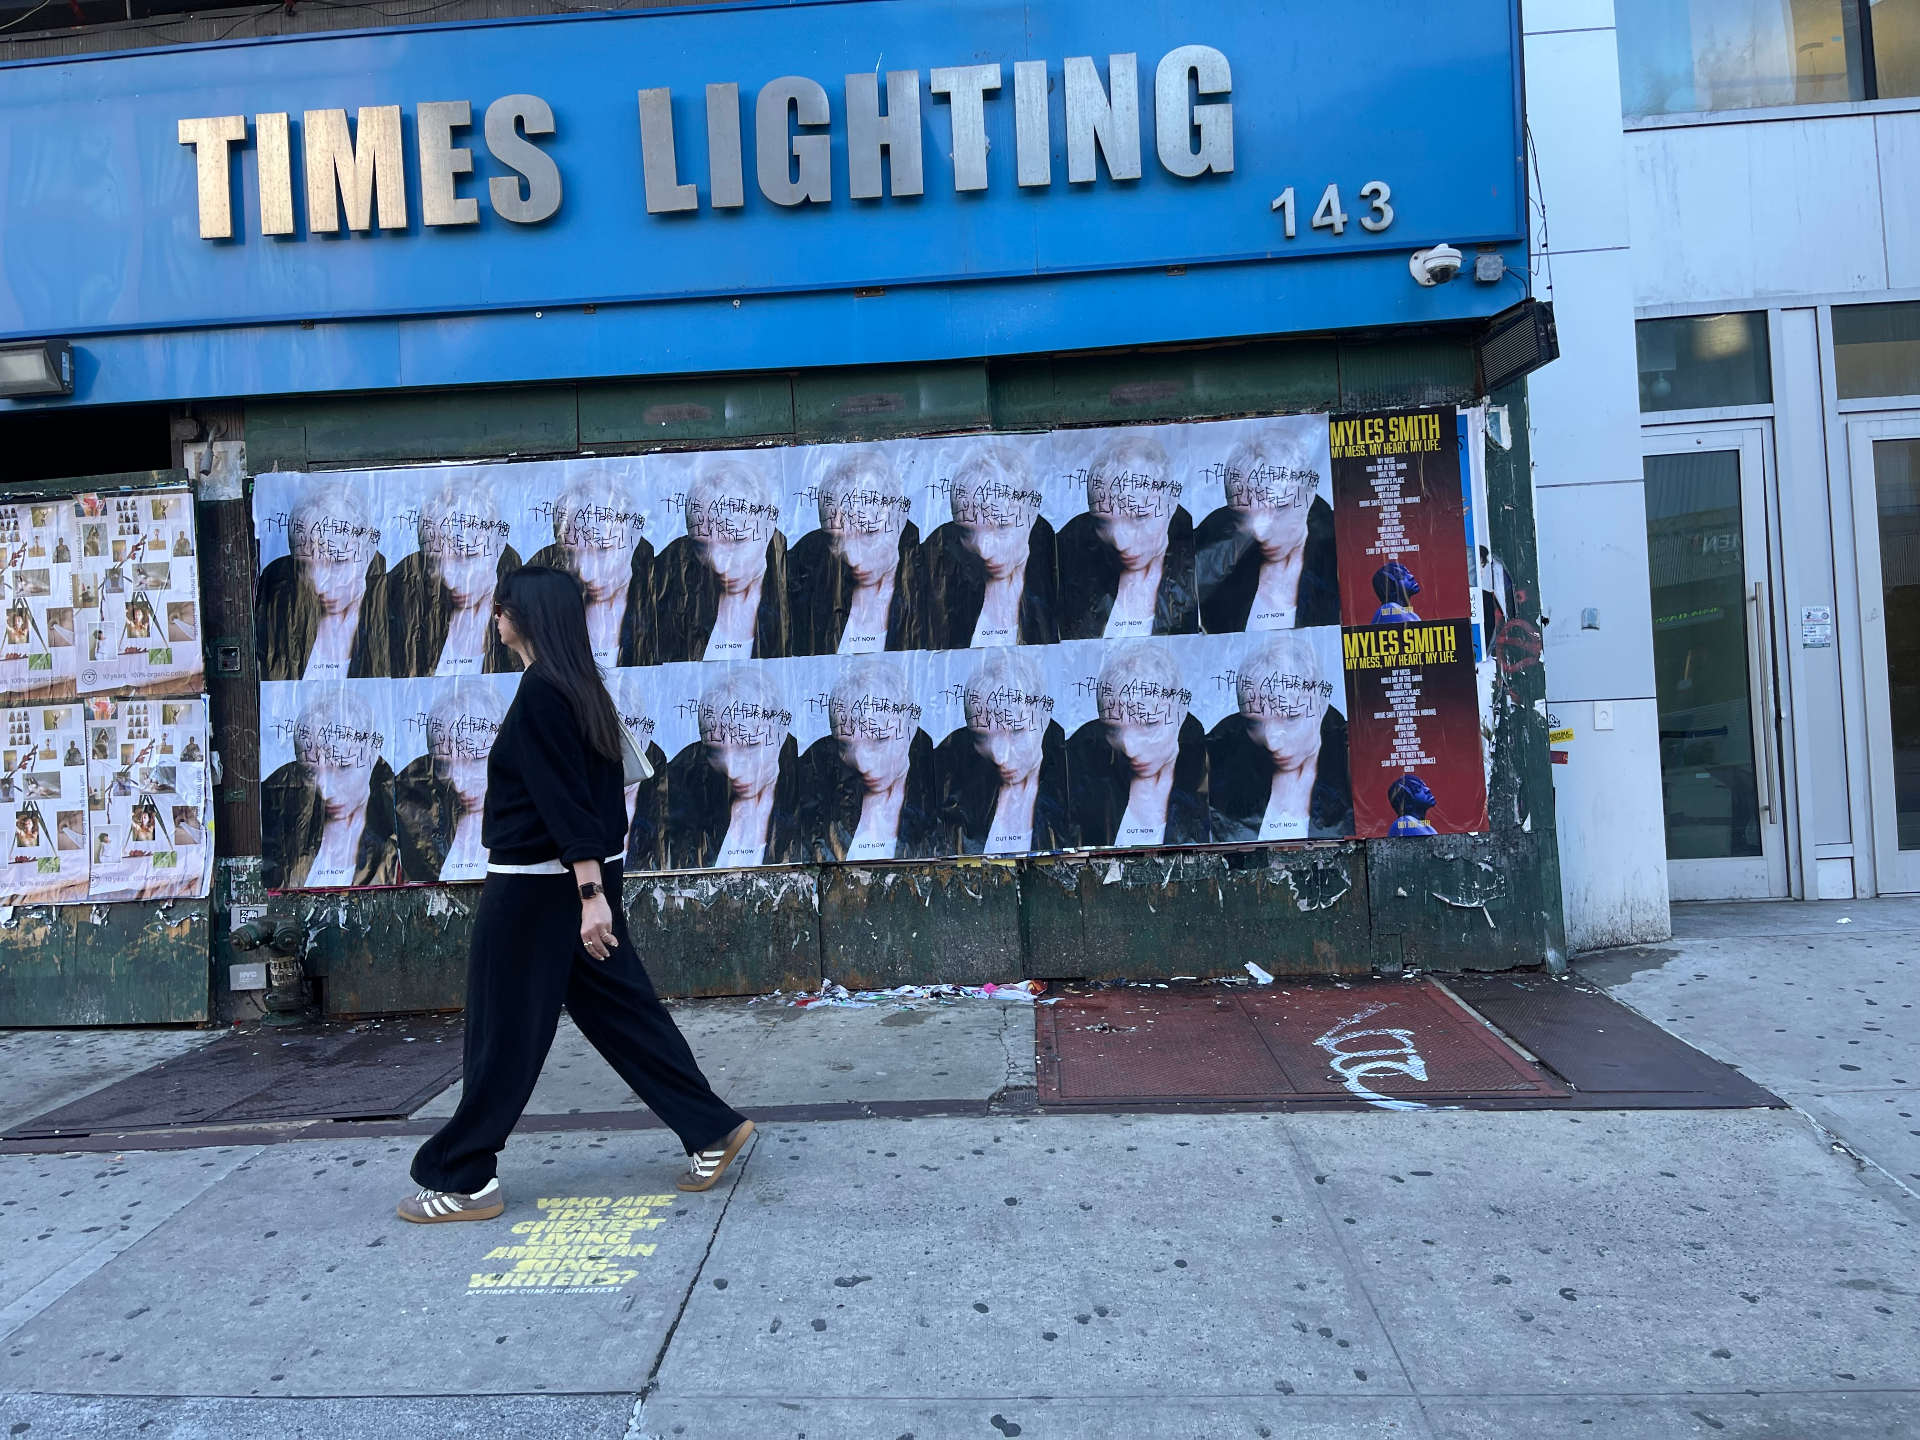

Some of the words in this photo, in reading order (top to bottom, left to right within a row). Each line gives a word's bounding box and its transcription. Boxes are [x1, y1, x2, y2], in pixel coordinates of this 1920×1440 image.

[178, 94, 562, 240] TIMES
[638, 44, 1233, 214] LIGHTING
[1271, 180, 1394, 237] 143
[1330, 418, 1384, 446] MYLES
[1388, 414, 1440, 442] SMITH
[1331, 446, 1344, 458] MY
[1345, 444, 1368, 458] MESS,
[1369, 443, 1381, 456] MY
[1384, 442, 1409, 454] HEART,
[1410, 440, 1422, 453] MY
[1424, 439, 1441, 452] LIFE.
[1344, 630, 1399, 658] MYLES
[1403, 626, 1456, 654] SMITH
[1346, 658, 1358, 670] MY
[1360, 657, 1382, 669] MESS,
[1385, 655, 1396, 667] MY
[1398, 654, 1424, 666] HEART,
[1426, 652, 1438, 664] MY
[1440, 651, 1457, 663] LIFE.
[27, 676, 50, 684] organic
[148, 670, 170, 678] organic
[537, 1197, 612, 1209] WHO
[611, 1195, 677, 1207] ARE
[547, 1208, 607, 1220] THE
[606, 1207, 650, 1219] 30
[511, 1218, 666, 1234] GREATEST
[525, 1232, 632, 1246] LIVING
[482, 1244, 658, 1260] AMERICAN
[468, 1270, 639, 1288] WRITERS?
